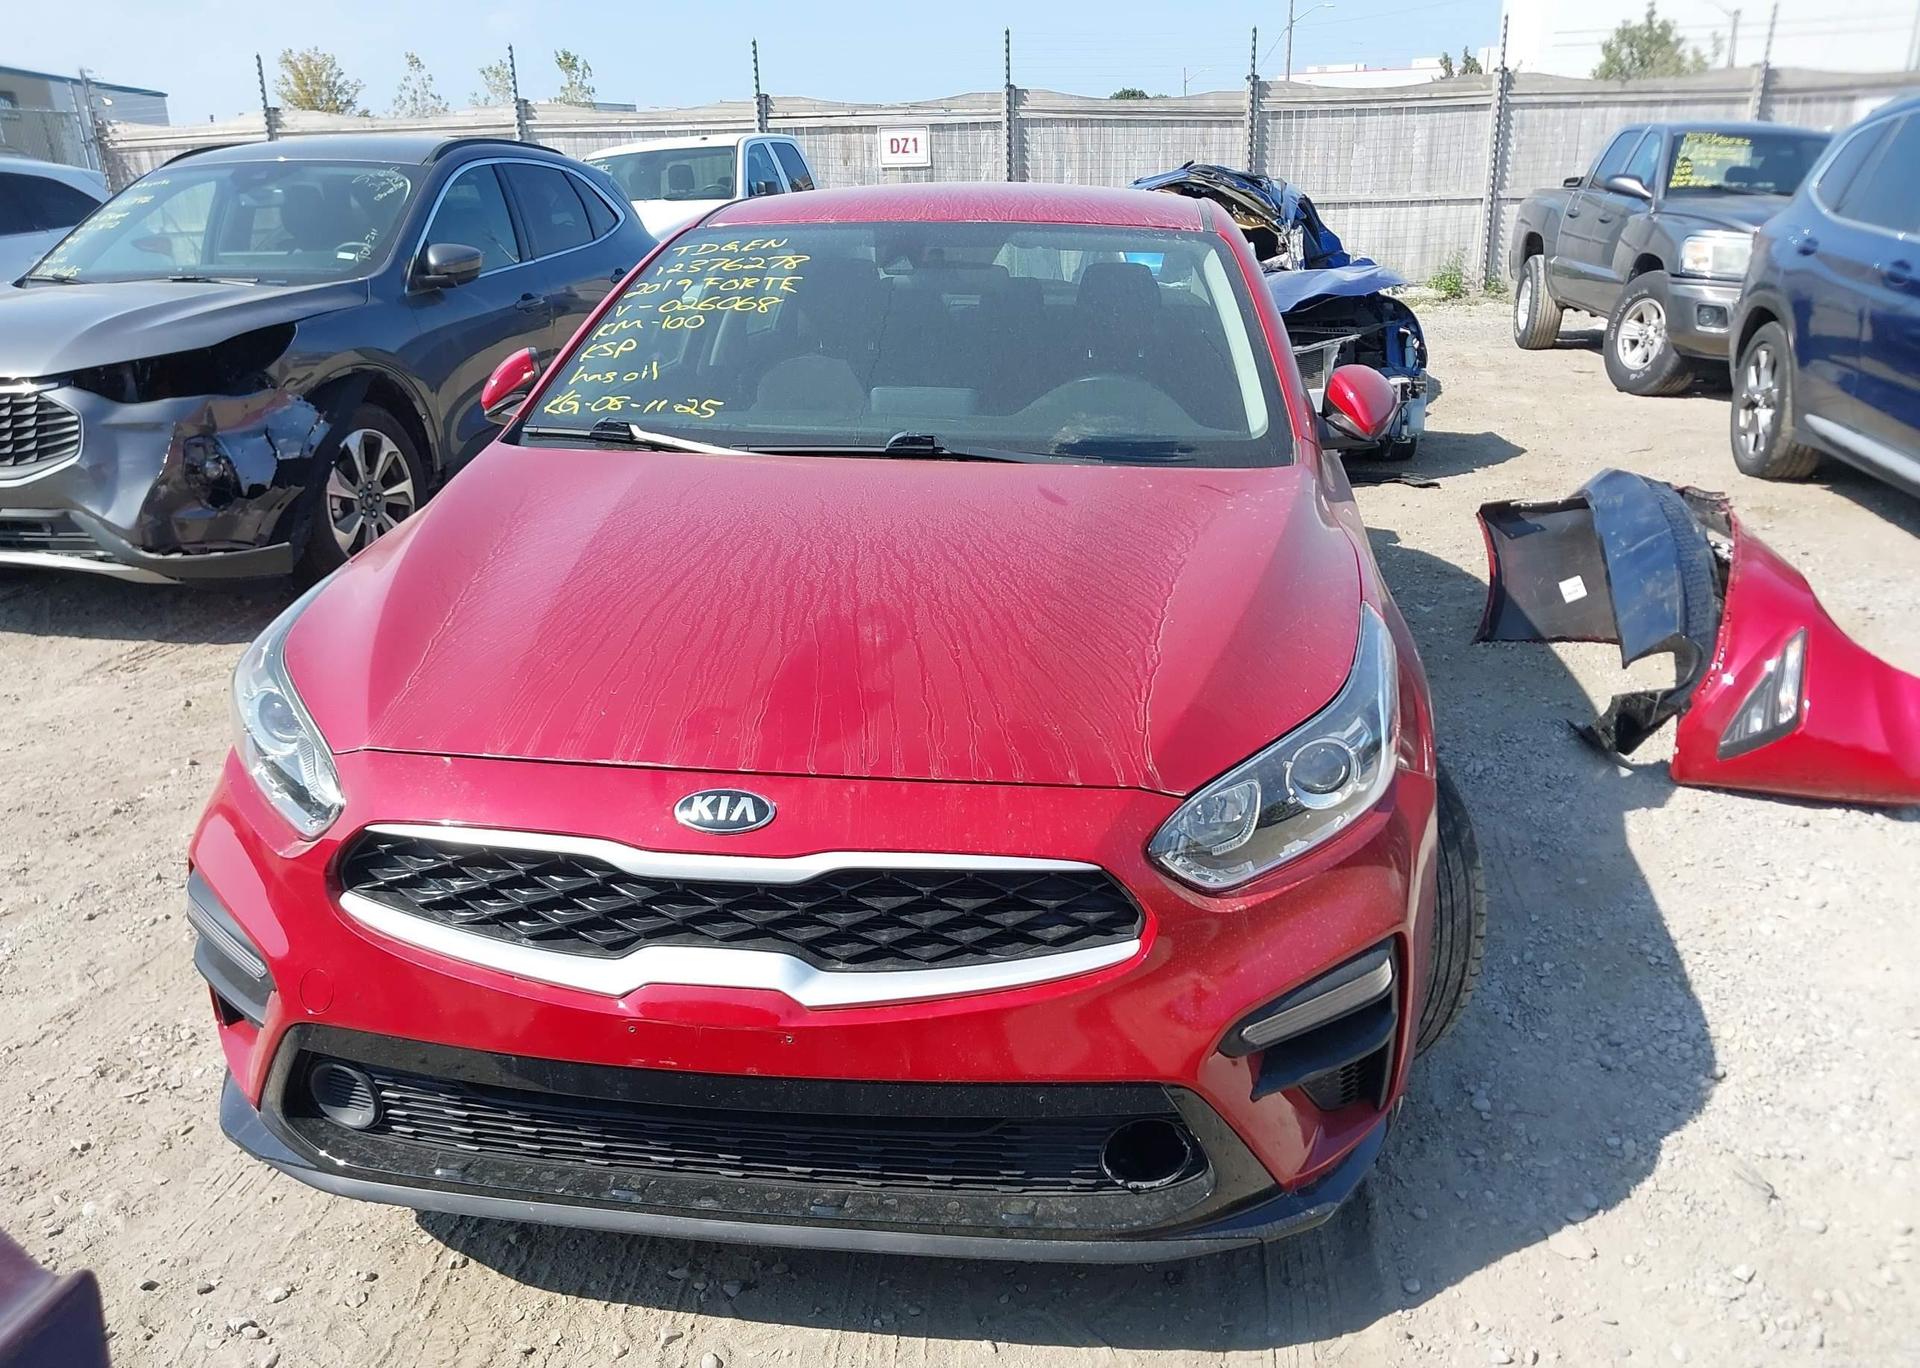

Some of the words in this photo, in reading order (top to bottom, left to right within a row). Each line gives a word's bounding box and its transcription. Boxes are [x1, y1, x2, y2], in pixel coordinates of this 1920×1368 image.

[890, 137, 918, 154] DZ1
[656, 255, 811, 276] 12376278
[623, 279, 692, 299] 2019
[703, 277, 803, 293] FORTE
[579, 338, 637, 362] KSP
[568, 366, 617, 385] has
[623, 361, 658, 381] oil
[690, 795, 757, 822] KIA
